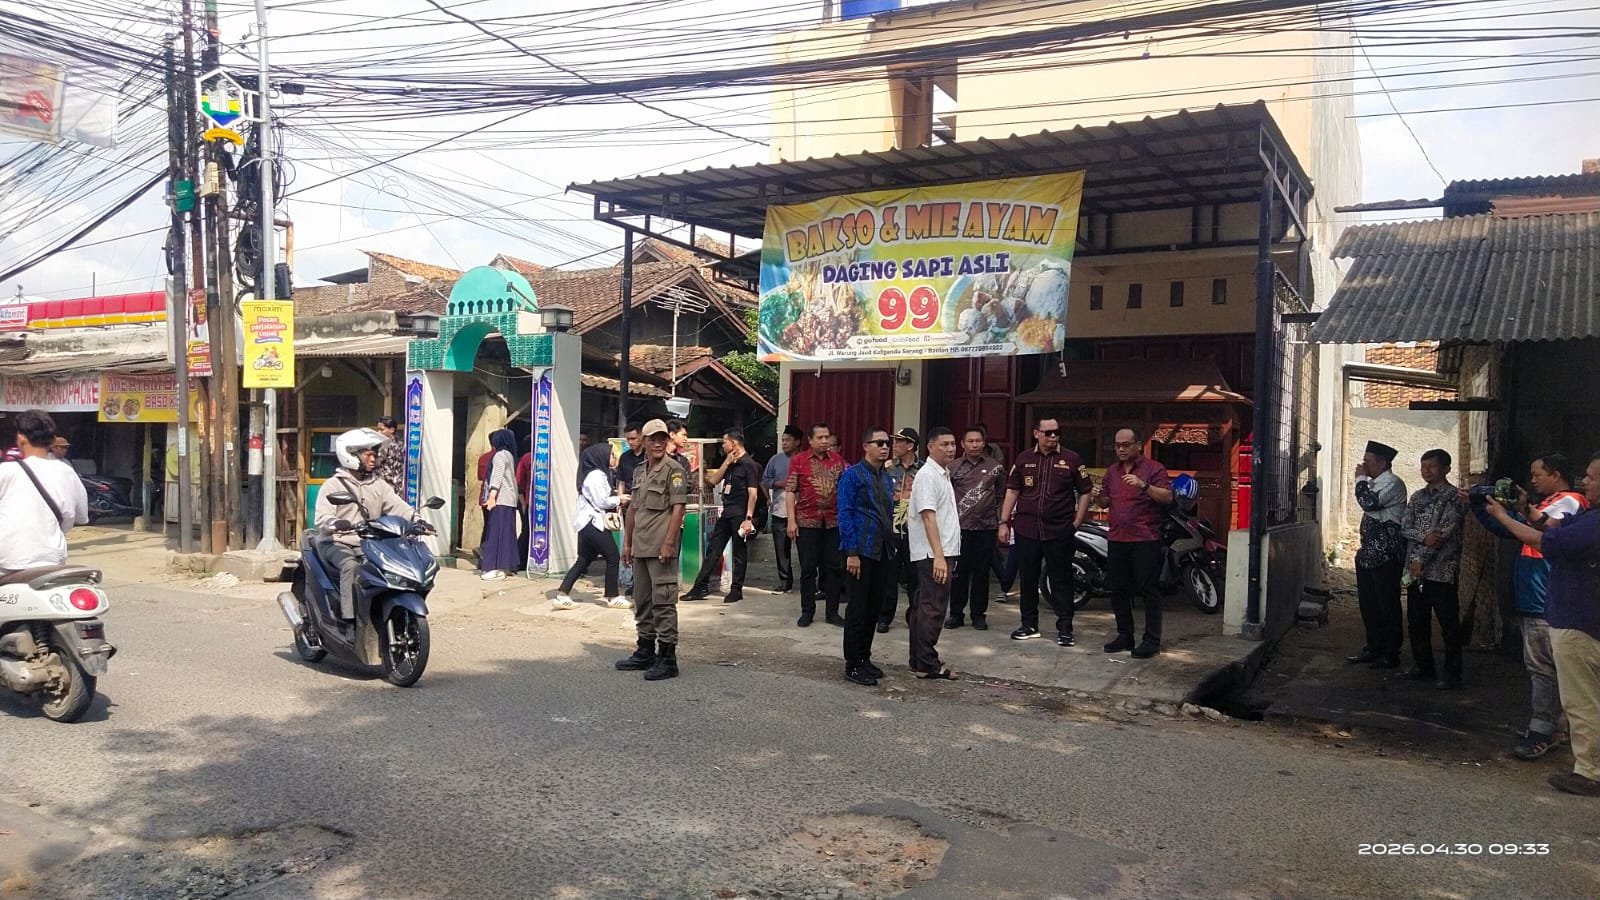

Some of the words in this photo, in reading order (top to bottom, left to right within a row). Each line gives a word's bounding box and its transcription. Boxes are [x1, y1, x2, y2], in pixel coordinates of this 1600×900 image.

[786, 209, 875, 262] BAKSO
[880, 206, 900, 242] &
[905, 202, 961, 239] MIE
[962, 202, 1058, 245] AYAM
[823, 260, 898, 284] DAGING
[902, 256, 954, 278] SAPI
[958, 253, 1009, 275] ASLI
[878, 287, 940, 330] 99
